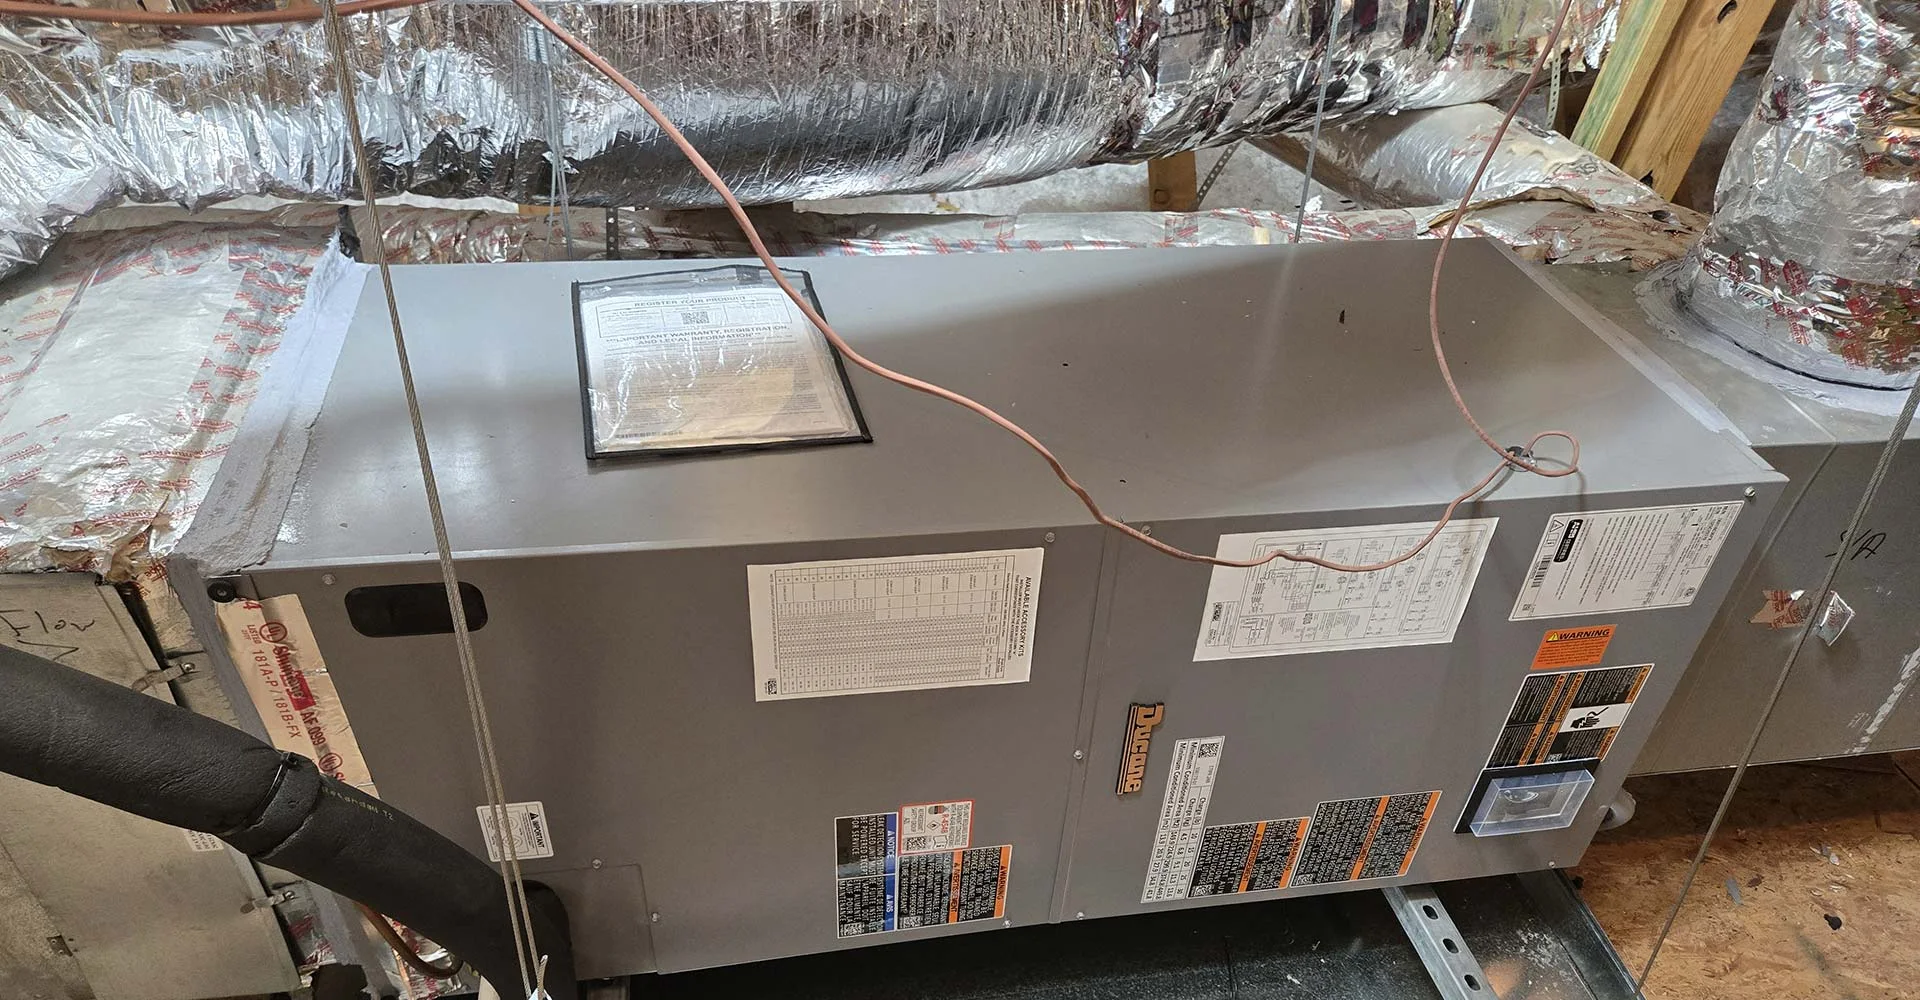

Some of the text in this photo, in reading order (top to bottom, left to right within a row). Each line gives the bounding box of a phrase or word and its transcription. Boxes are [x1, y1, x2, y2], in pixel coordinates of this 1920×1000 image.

[634, 299, 678, 307] REGISTER
[1022, 576, 1032, 608] AVAILABLE
[0, 609, 95, 637] Flow
[247, 624, 262, 645] LISTED
[1019, 609, 1028, 643] ACCESSORY
[1559, 628, 1610, 640] WARNING
[252, 649, 278, 687] 181A-P
[273, 697, 302, 738] 181B-FX
[300, 711, 318, 725] AF
[308, 727, 326, 746] 099
[1124, 704, 1163, 792] Ducane
[1173, 742, 1186, 770] Minimum
[1184, 741, 1197, 770] Minimum
[1166, 771, 1180, 804] Conditioned
[1176, 770, 1191, 803] Conditioned
[1163, 805, 1172, 817] Area
[1173, 804, 1183, 816] Area
[1184, 797, 1196, 815] Charge
[1194, 797, 1206, 815] Charge
[532, 821, 545, 848] IMPORTANT
[851, 816, 859, 828] FOR
[970, 849, 978, 869] SERVICE
[950, 868, 960, 912] AVERTISSEMENT
[987, 881, 996, 911] FLAMMABLE
[996, 869, 1006, 900] WARNING
[966, 901, 974, 909] DO
